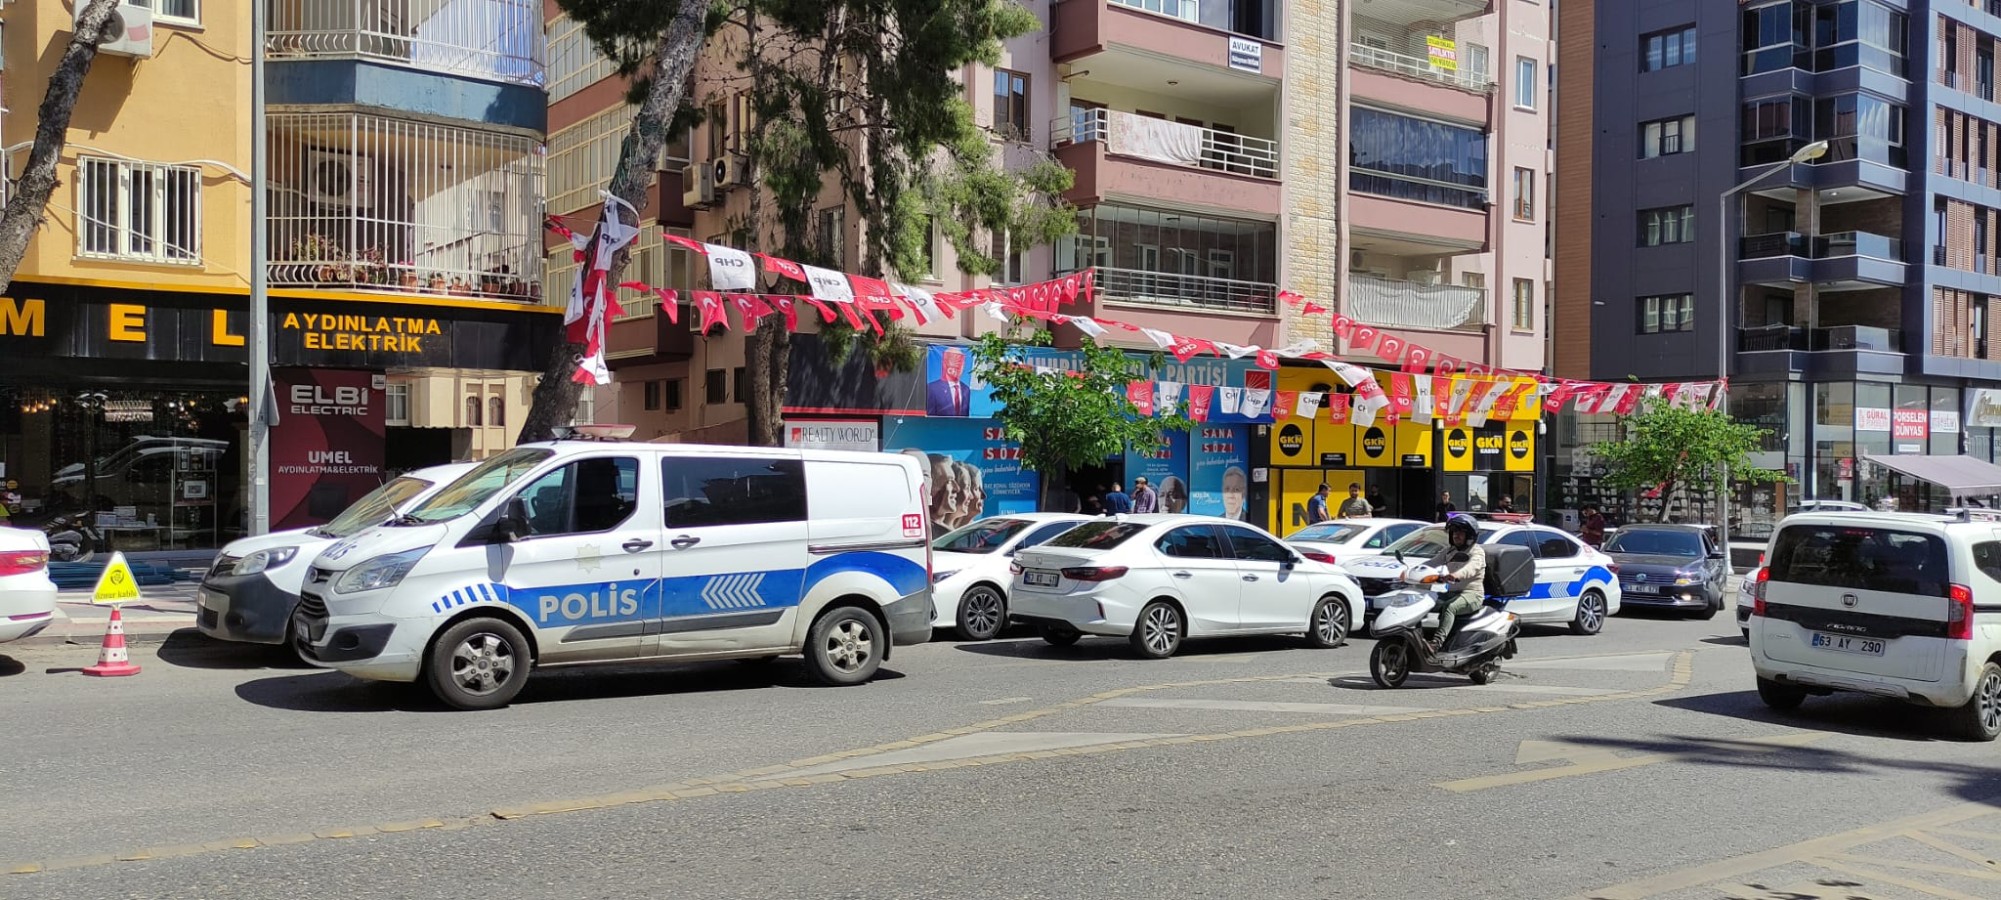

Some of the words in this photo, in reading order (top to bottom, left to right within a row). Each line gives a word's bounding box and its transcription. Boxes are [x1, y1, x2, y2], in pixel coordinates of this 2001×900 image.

[1232, 41, 1259, 53] AVUKAT
[283, 312, 441, 335] AYDINLATMA
[304, 332, 422, 352] ELEKTRİK
[1167, 361, 1227, 387] PARTİSİ
[291, 405, 368, 415] ELECTRIC
[1893, 412, 1927, 423] PORSELEN
[802, 427, 835, 442] REALTY
[837, 427, 873, 443] WORLD
[1203, 428, 1233, 439] SANA
[1895, 423, 1924, 437] DÜNYASI
[1280, 435, 1302, 444] GKN
[1364, 437, 1385, 446] GKN
[1476, 437, 1503, 449] GKN
[986, 444, 1020, 460] SÖZ
[1203, 441, 1233, 453] SÖZ!
[308, 451, 353, 464] UMEL
[278, 464, 378, 474] AYDINLATMA&ELEKTRİK
[904, 516, 919, 528] 112
[539, 583, 638, 623] POLİS
[1819, 634, 1831, 647] 63
[1838, 639, 1851, 650] AY
[1861, 641, 1881, 653] 290
